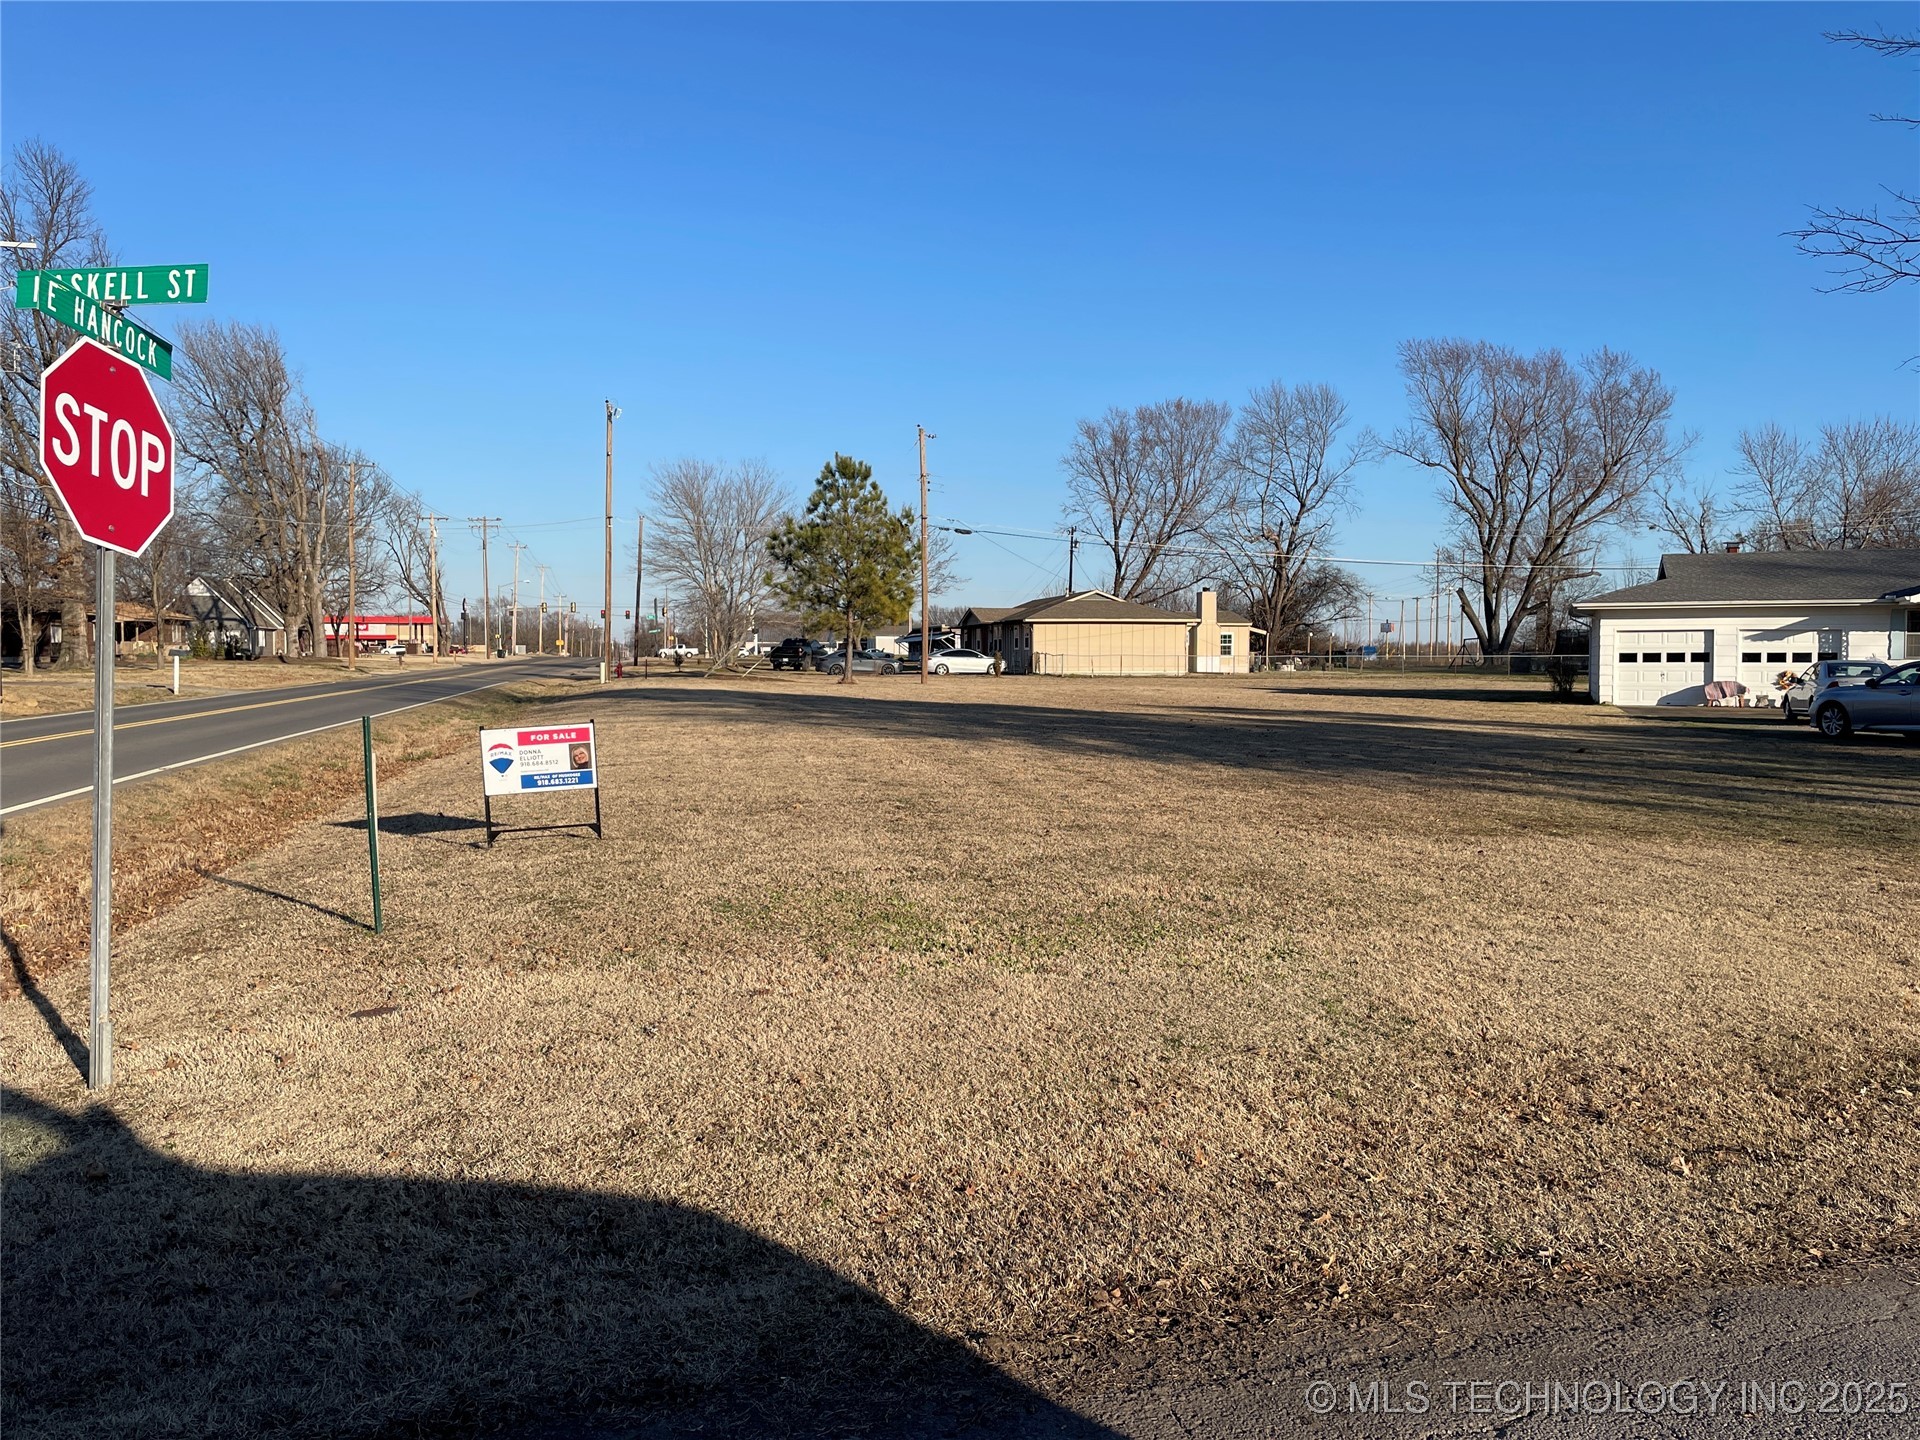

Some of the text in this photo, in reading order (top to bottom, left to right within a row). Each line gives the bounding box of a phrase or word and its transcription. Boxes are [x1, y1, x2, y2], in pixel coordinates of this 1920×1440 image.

[33, 269, 197, 303] SKELL ST
[47, 280, 158, 368] E HANCOCK
[52, 392, 166, 498] STOP
[553, 732, 577, 740] SALE
